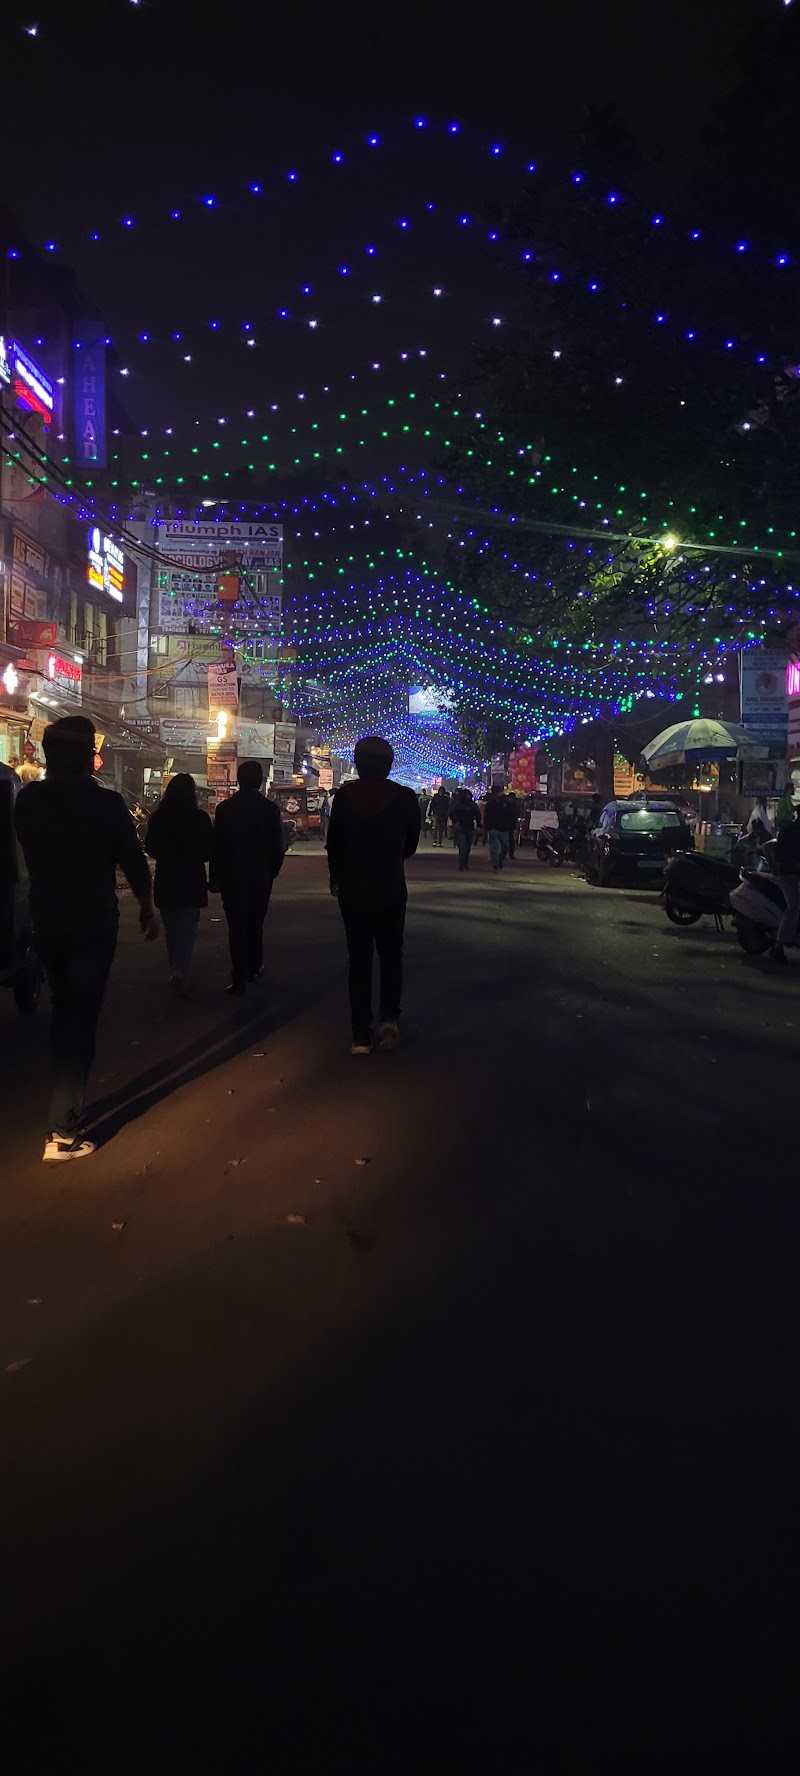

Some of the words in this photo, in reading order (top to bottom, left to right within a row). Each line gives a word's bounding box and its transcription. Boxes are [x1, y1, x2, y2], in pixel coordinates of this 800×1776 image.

[82, 353, 98, 460] AHEAD
[164, 523, 241, 536] Triumph
[248, 526, 279, 536] IAS
[217, 675, 228, 683] GS
